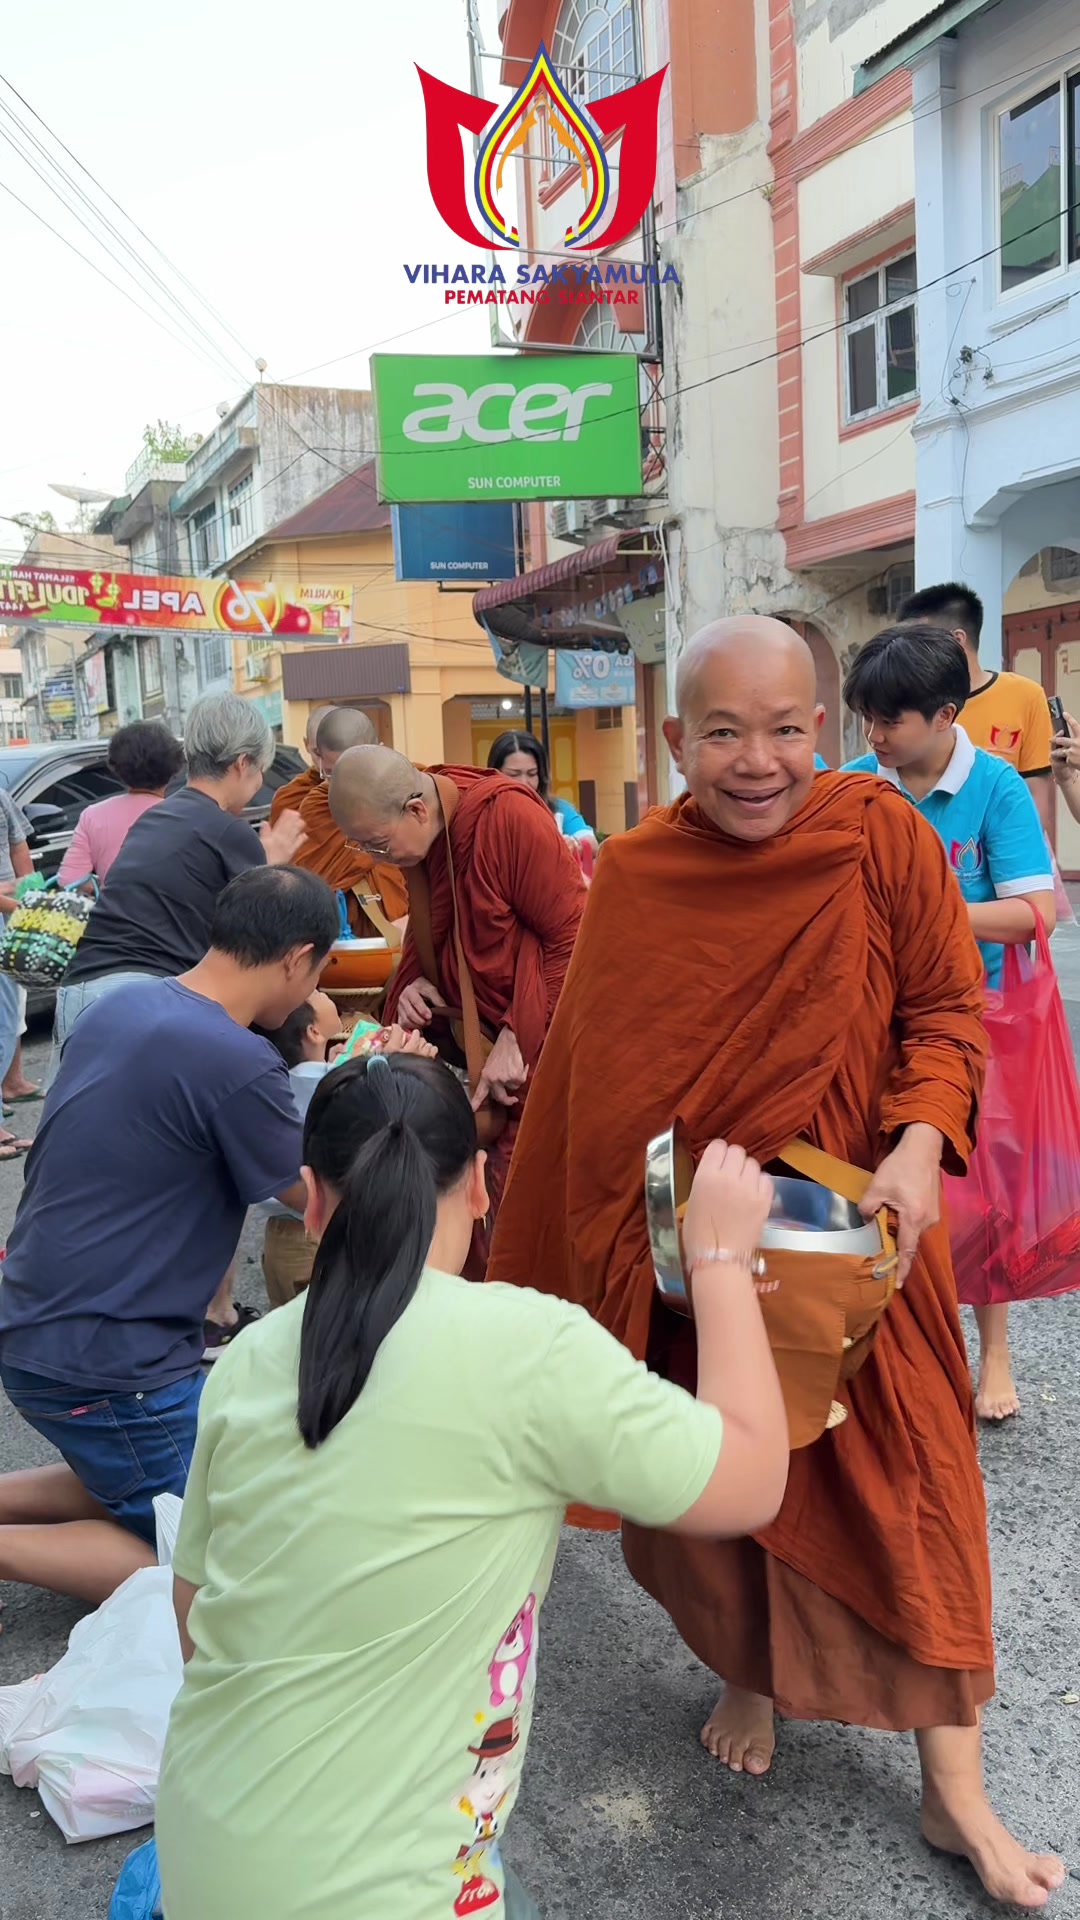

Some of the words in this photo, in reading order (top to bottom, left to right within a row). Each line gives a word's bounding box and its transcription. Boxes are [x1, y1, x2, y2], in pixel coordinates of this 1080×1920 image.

[402, 382, 612, 443] acer
[467, 477, 493, 489] SUN
[496, 476, 561, 488] COMPUTER
[430, 562, 446, 570] SUN
[447, 561, 488, 570] COMPUTER
